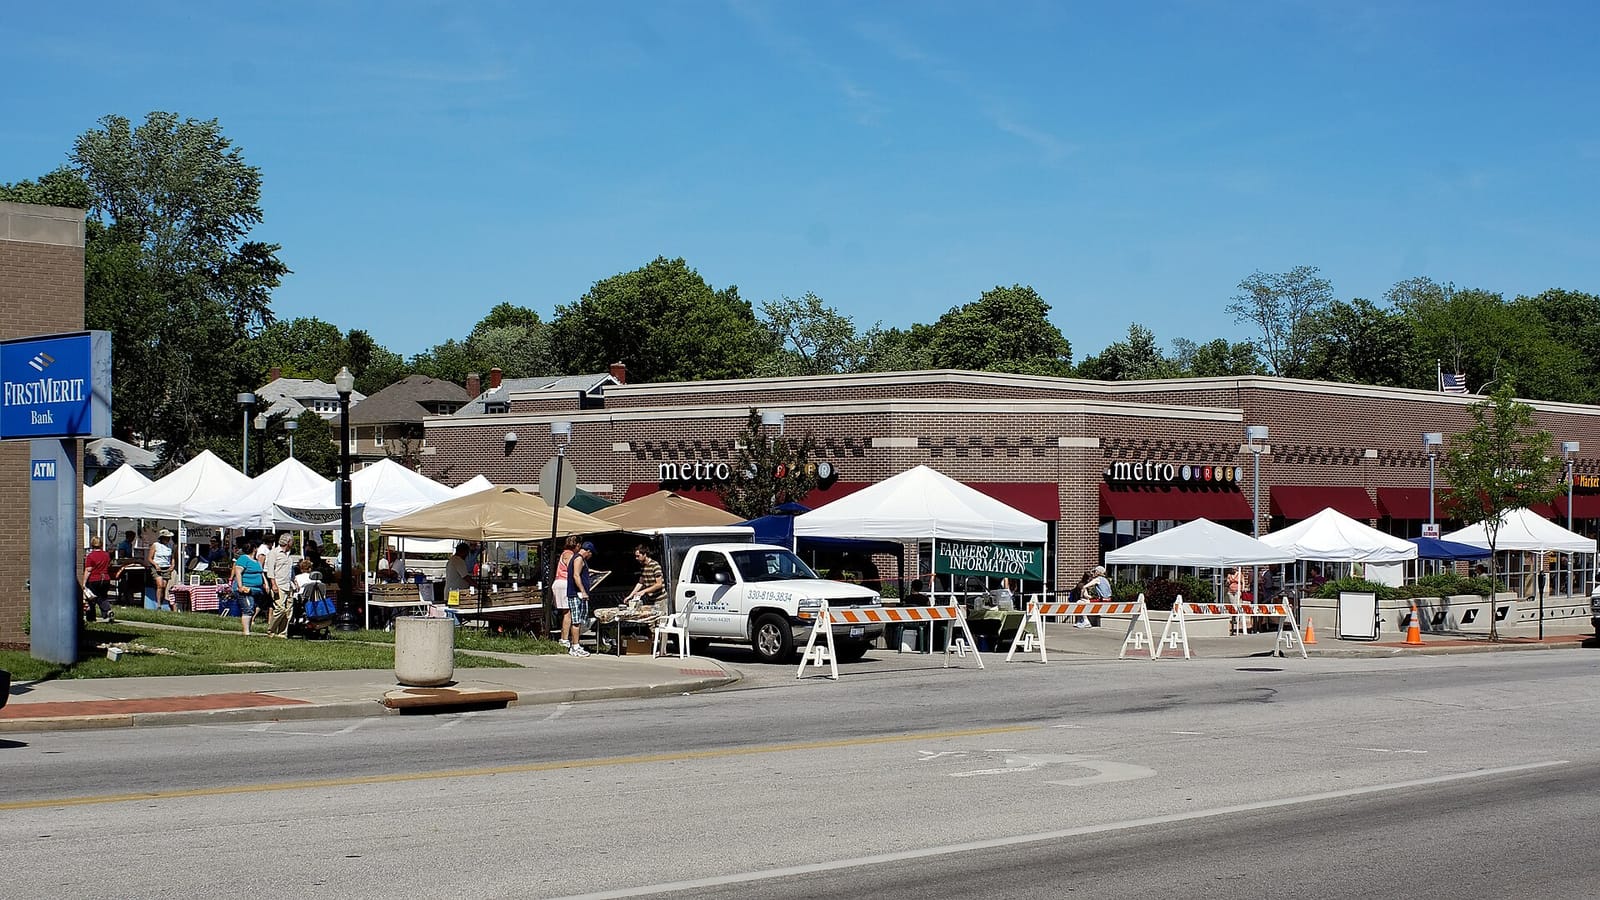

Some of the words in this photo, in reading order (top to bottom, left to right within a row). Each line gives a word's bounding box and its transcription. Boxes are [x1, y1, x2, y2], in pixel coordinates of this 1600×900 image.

[4, 378, 84, 406] FIRSTMERIT
[31, 410, 54, 425] Bank
[33, 463, 55, 477] ATM
[658, 460, 730, 480] metro
[1113, 459, 1175, 481] metro
[1182, 465, 1243, 481] BURGER
[1580, 474, 1600, 488] Market
[304, 509, 343, 523] Sharpenin
[940, 542, 992, 558] FARMERS'
[993, 547, 1035, 564] MARKET
[950, 556, 1025, 574] INFORMATION
